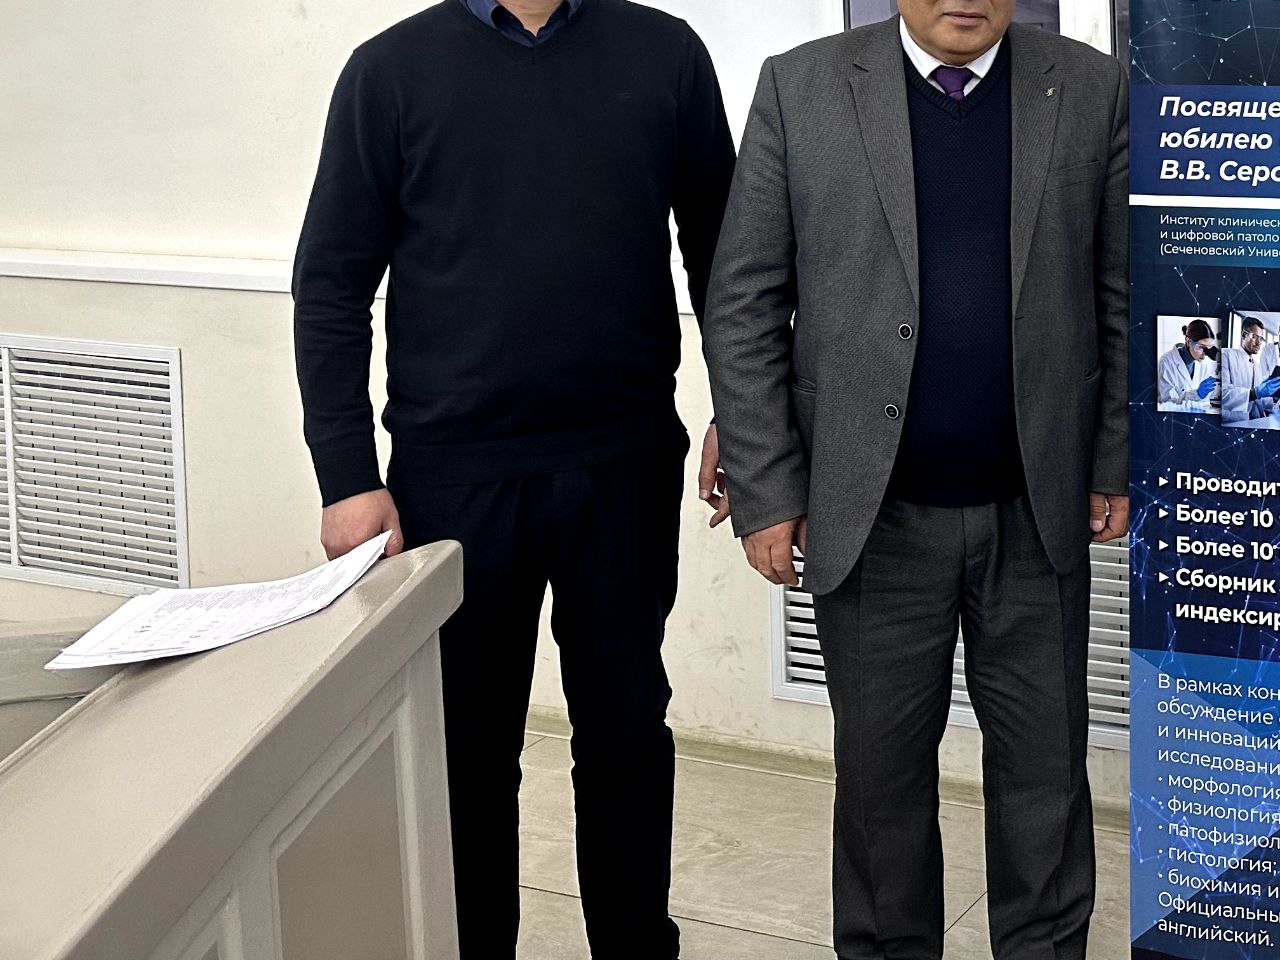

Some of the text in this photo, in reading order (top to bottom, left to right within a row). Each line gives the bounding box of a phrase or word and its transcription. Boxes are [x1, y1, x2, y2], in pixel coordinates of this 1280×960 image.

[1159, 126, 1273, 150] юбилею
[1159, 159, 1212, 181] В.В.
[1159, 214, 1215, 229] Институт
[1159, 230, 1168, 240] и
[1171, 229, 1235, 244] цифровой
[1159, 243, 1245, 257] (Сеченовский
[1175, 504, 1244, 526] Более
[1250, 508, 1274, 529] 10
[1175, 536, 1244, 558] Более
[1251, 541, 1274, 561] 10
[1175, 567, 1277, 595] Сборник
[1158, 673, 1171, 690] В
[1175, 679, 1243, 700] рамках
[1157, 699, 1274, 726] обсуждение
[1158, 724, 1170, 738] и
[1168, 847, 1278, 875] гистология;
[1168, 868, 1262, 897] биохимия
[1268, 884, 1280, 899] и
[1158, 918, 1275, 948] английский.
